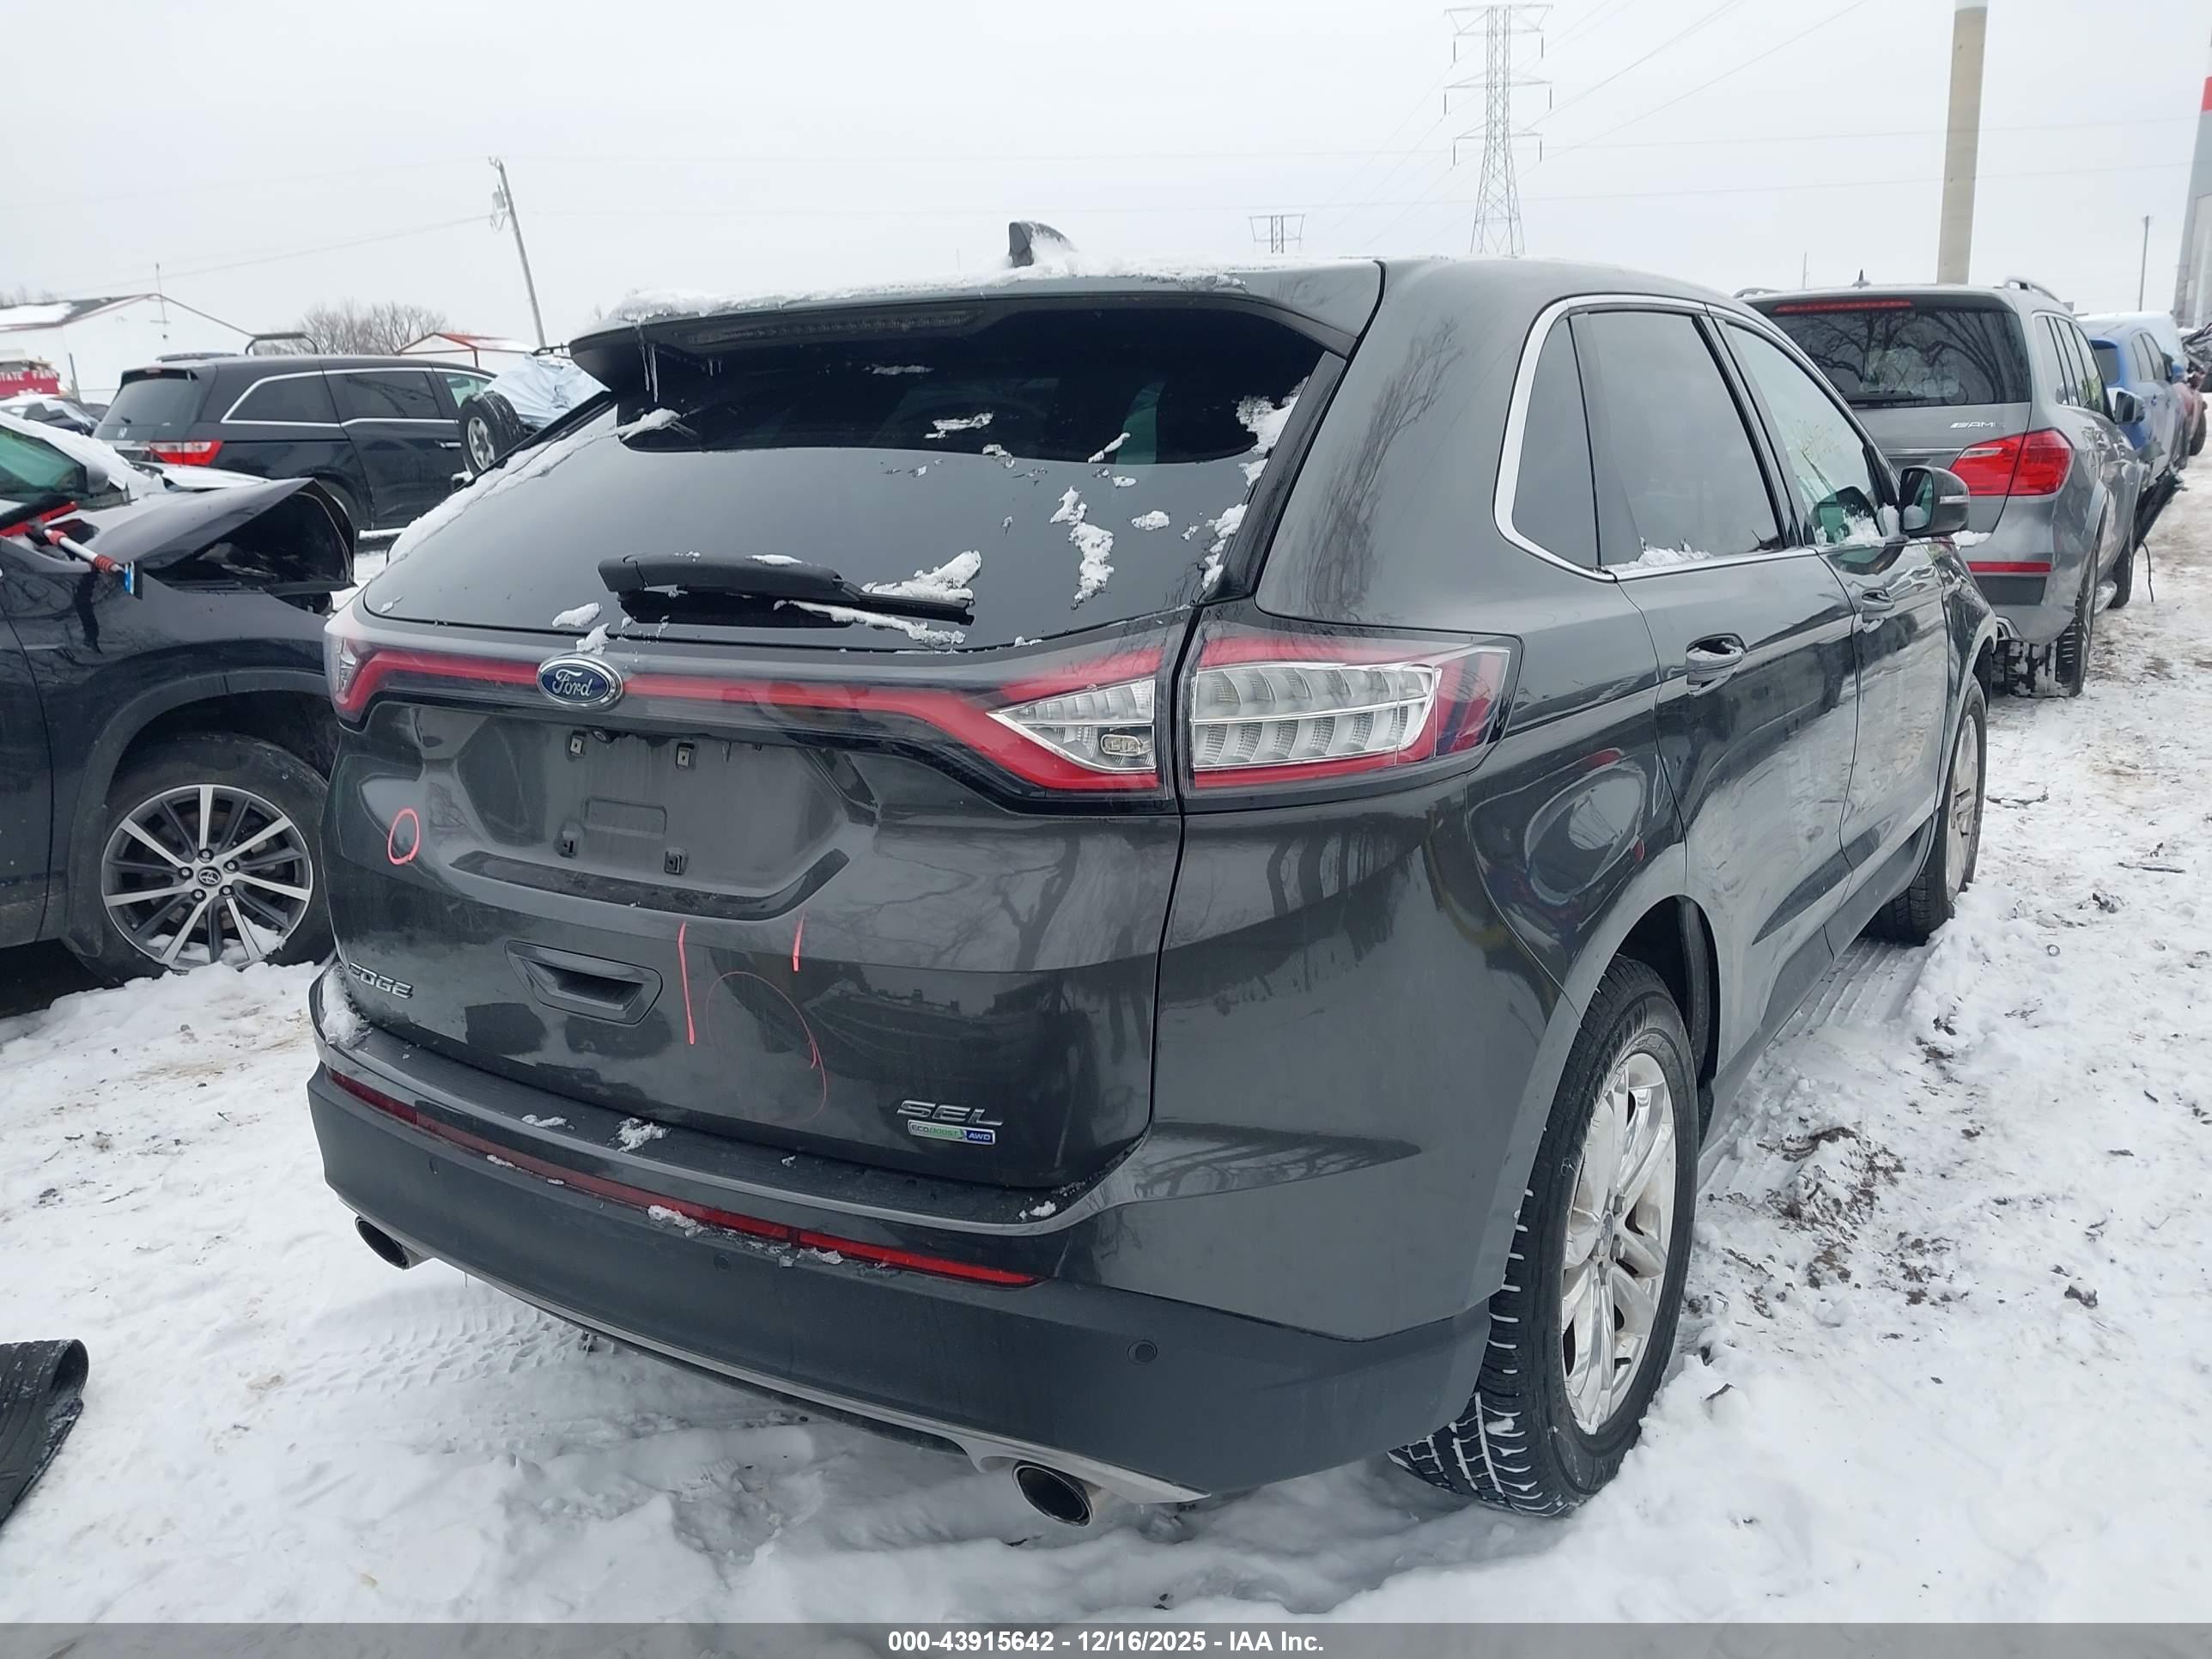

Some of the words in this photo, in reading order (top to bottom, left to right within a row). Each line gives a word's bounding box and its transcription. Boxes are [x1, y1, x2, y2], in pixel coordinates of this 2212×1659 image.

[552, 669, 592, 697] Ford
[349, 962, 413, 1000] EDGE
[896, 1099, 1004, 1127] SEL
